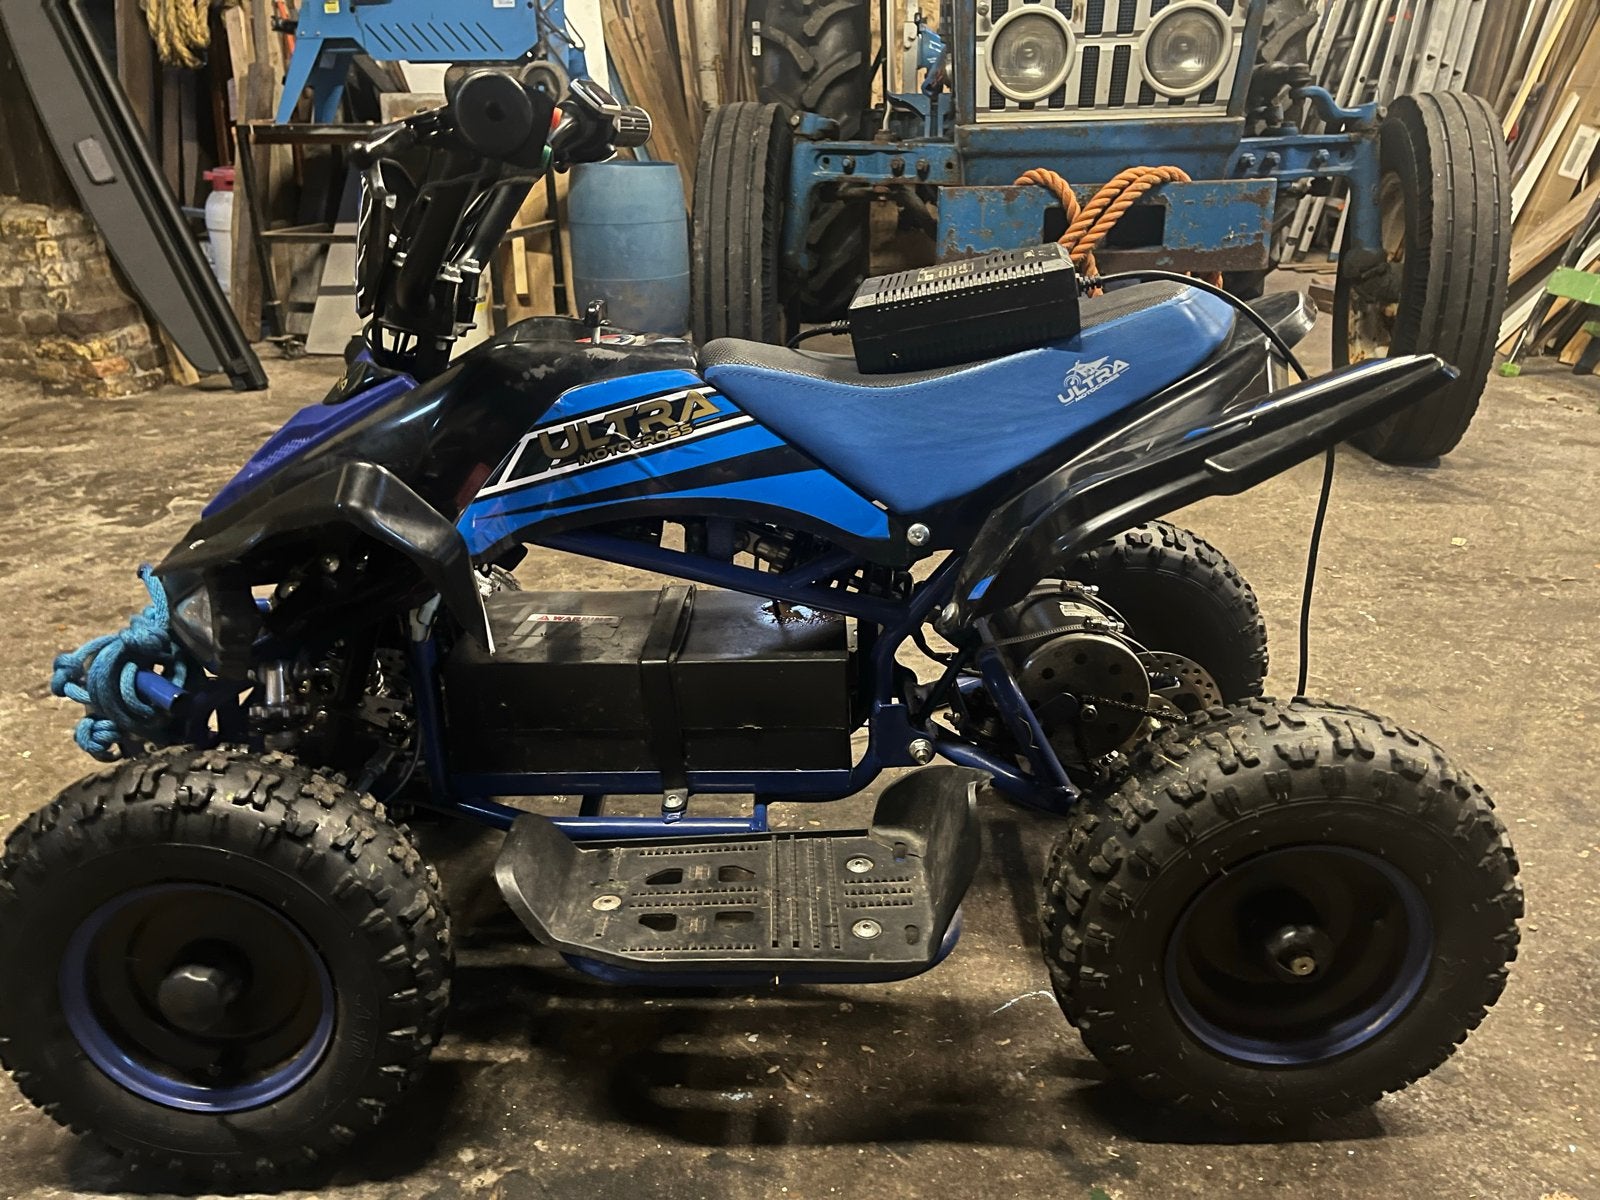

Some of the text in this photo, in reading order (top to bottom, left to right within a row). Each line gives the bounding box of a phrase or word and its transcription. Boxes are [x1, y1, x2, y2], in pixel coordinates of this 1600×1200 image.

[1057, 360, 1130, 403] ULTRA
[1075, 373, 1120, 402] MOTOCRO
[538, 391, 721, 459] ULTRA
[578, 424, 694, 466] MOTOCROSS
